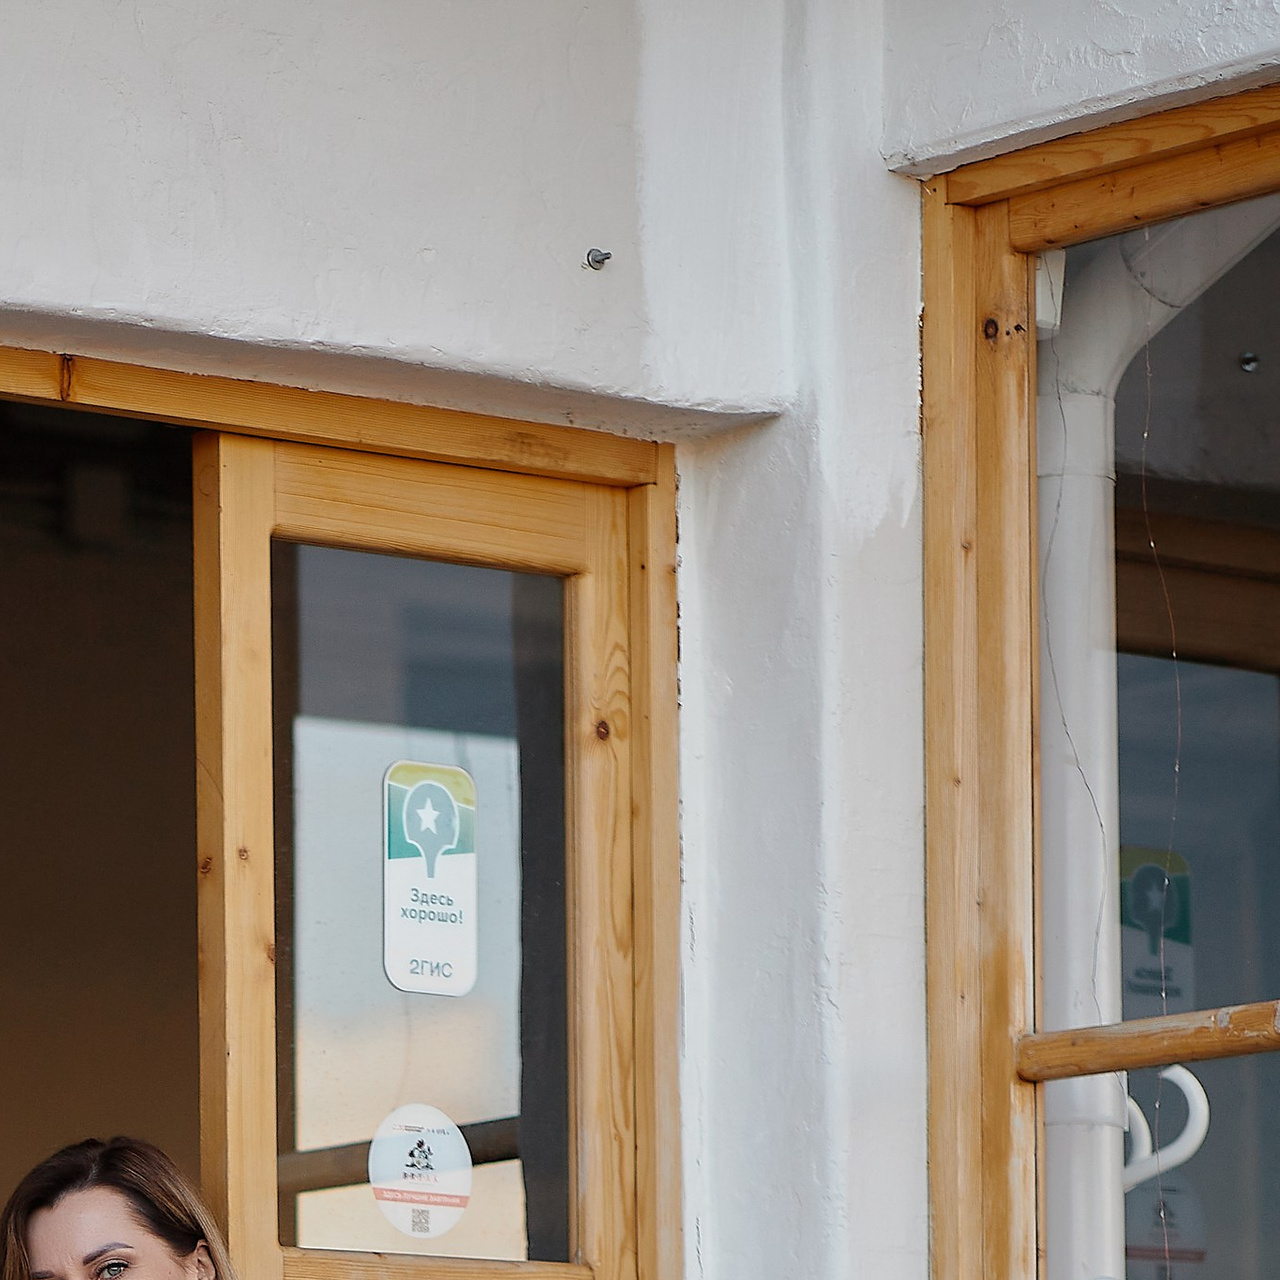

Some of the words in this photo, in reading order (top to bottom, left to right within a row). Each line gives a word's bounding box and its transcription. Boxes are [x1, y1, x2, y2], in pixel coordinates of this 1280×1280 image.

[410, 887, 454, 907] Здесь
[400, 907, 463, 924] хорошо!
[409, 958, 454, 979] 2ГИС
